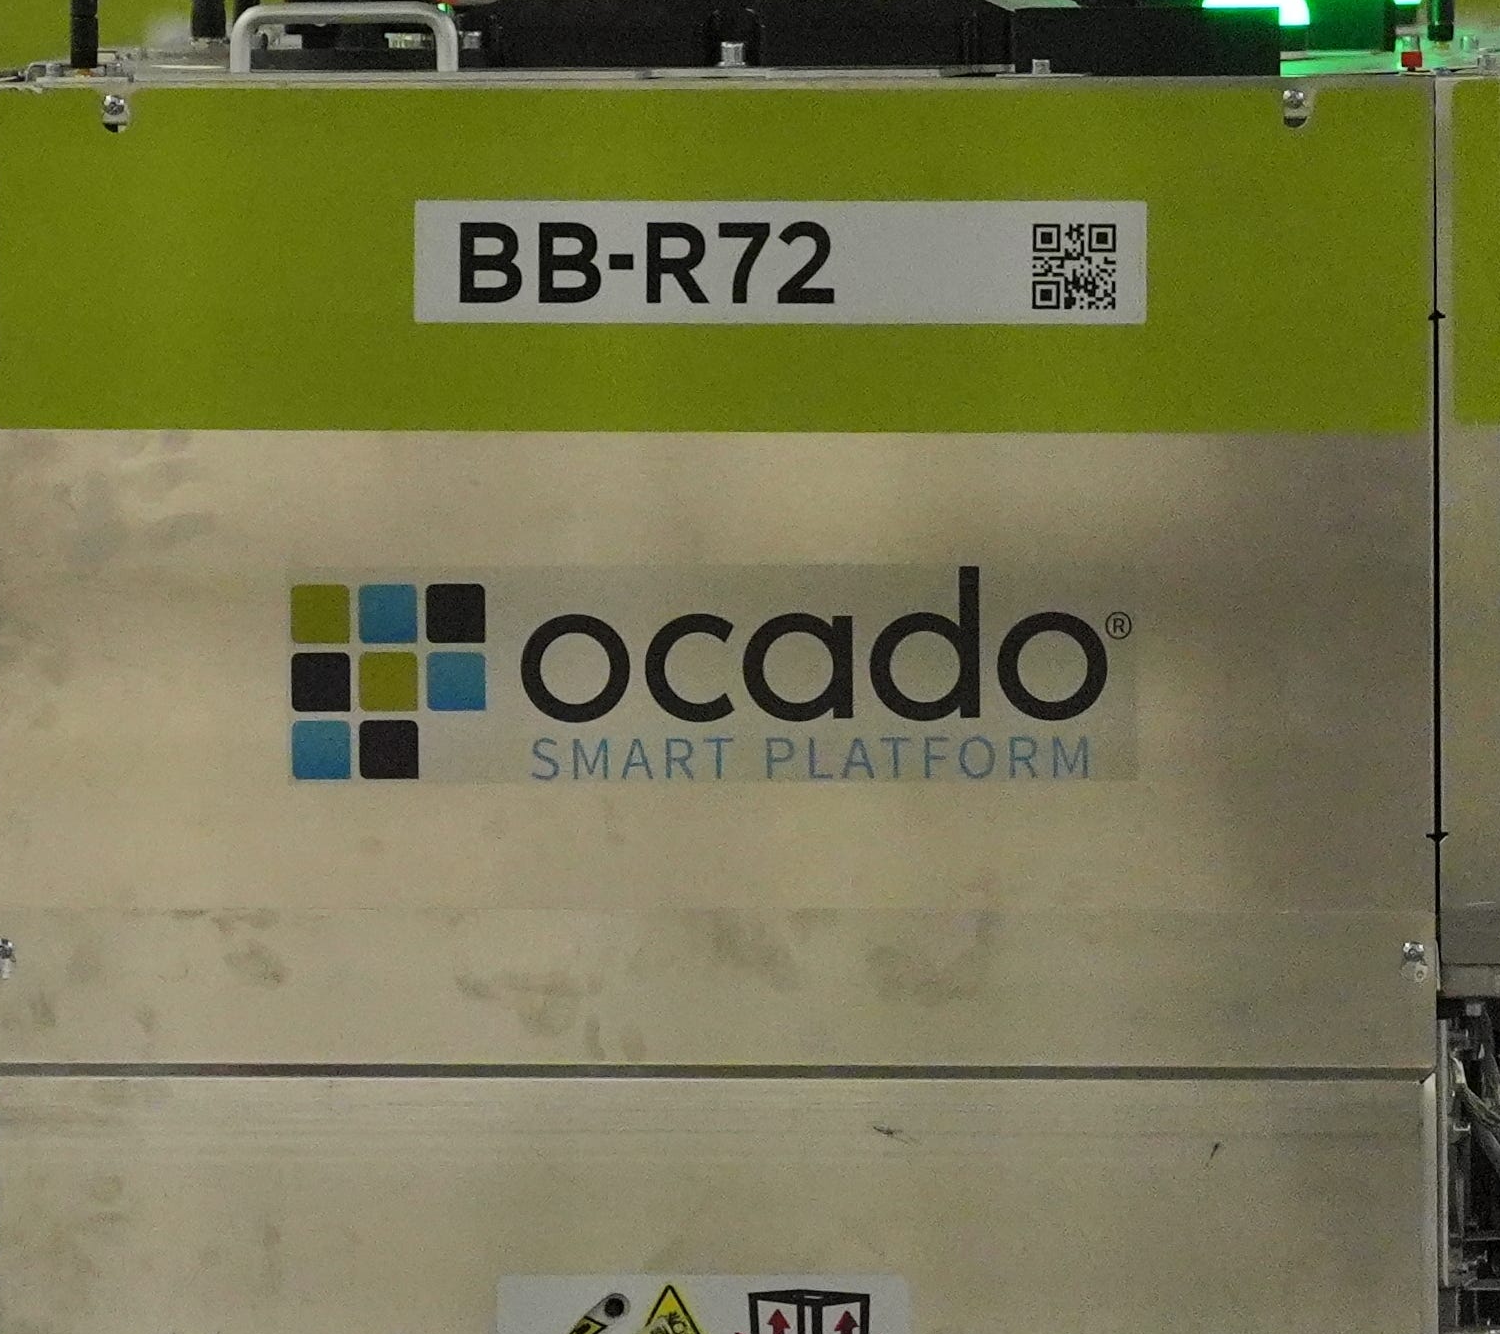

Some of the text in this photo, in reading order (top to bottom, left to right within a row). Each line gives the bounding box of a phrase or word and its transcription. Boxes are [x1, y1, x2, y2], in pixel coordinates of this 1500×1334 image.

[457, 220, 836, 305] BB-R72
[531, 735, 1092, 781] SMART PLATFORM
